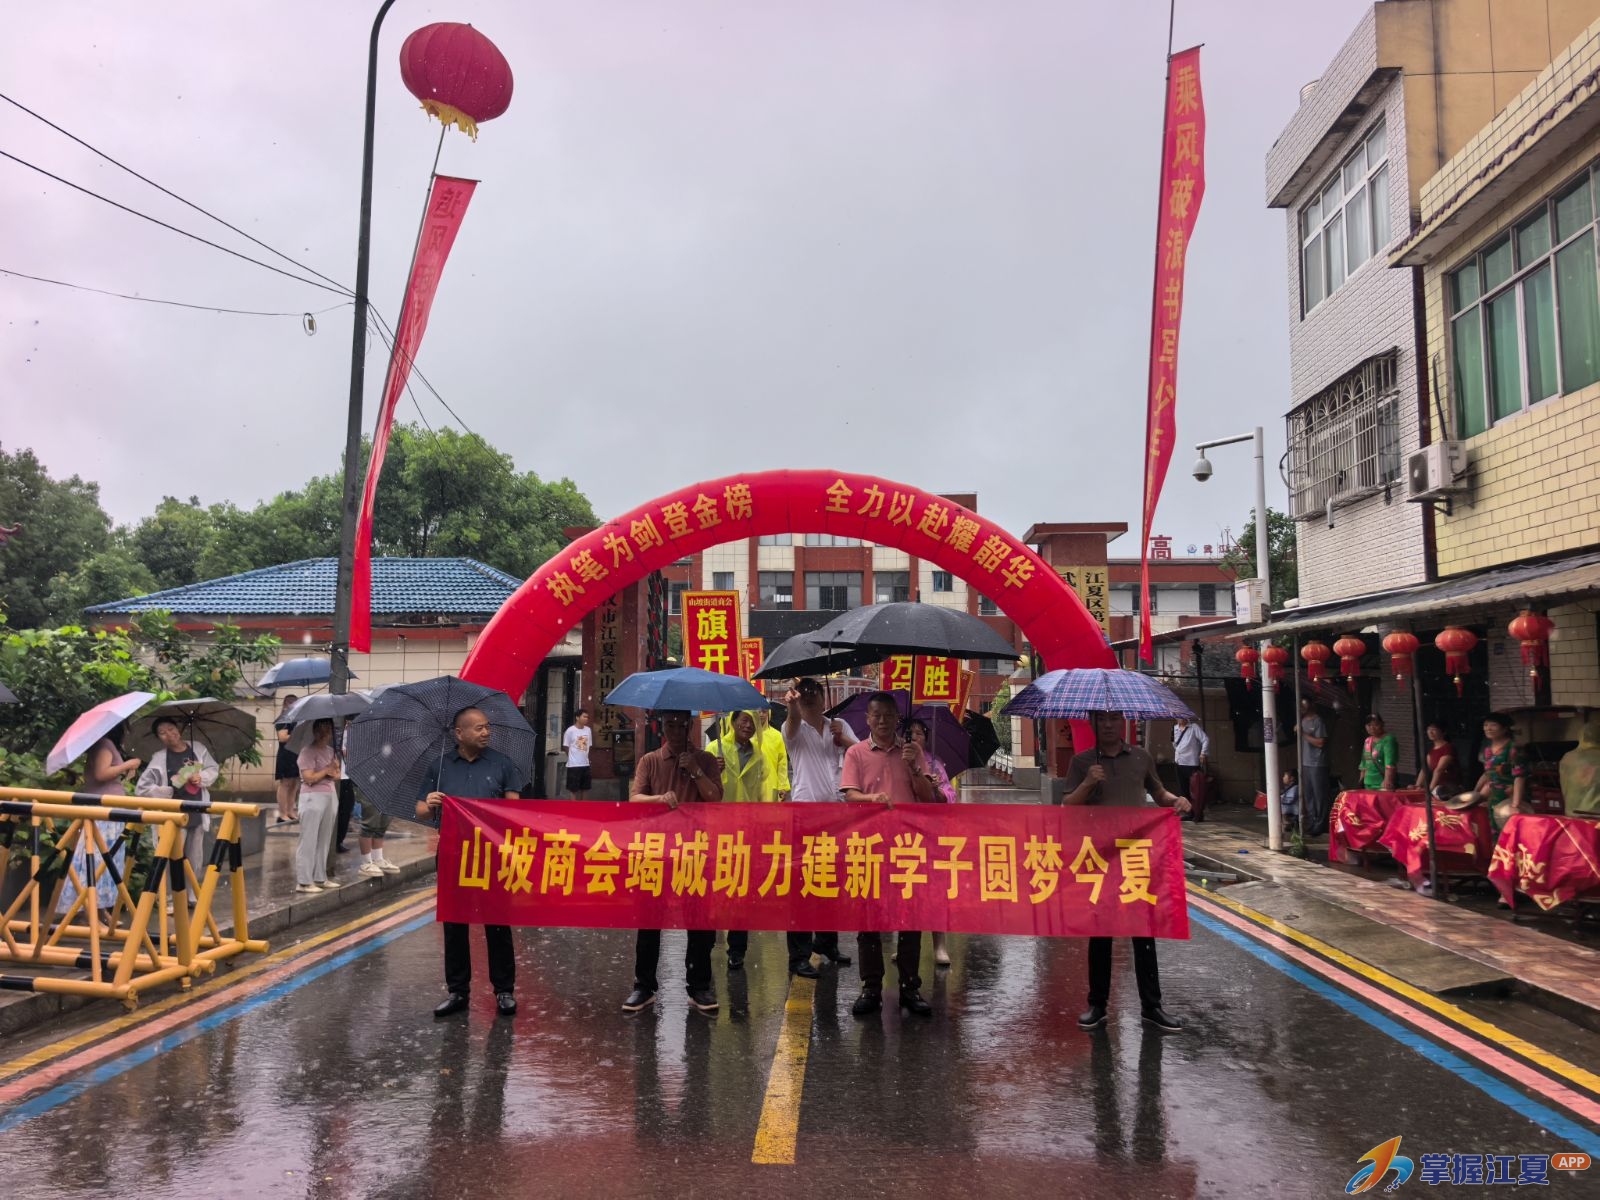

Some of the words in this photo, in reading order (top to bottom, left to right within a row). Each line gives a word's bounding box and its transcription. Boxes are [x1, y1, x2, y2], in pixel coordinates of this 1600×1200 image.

[546, 483, 753, 606] 执笔为剑登金榜
[825, 479, 1036, 589] 全力以赴耀韶华
[1150, 534, 1172, 559] 高
[1085, 572, 1106, 631] 江夏区第
[697, 609, 730, 675] 旗开
[458, 826, 1158, 906] 山坡商会竭诚助力建新学子圆梦今夏
